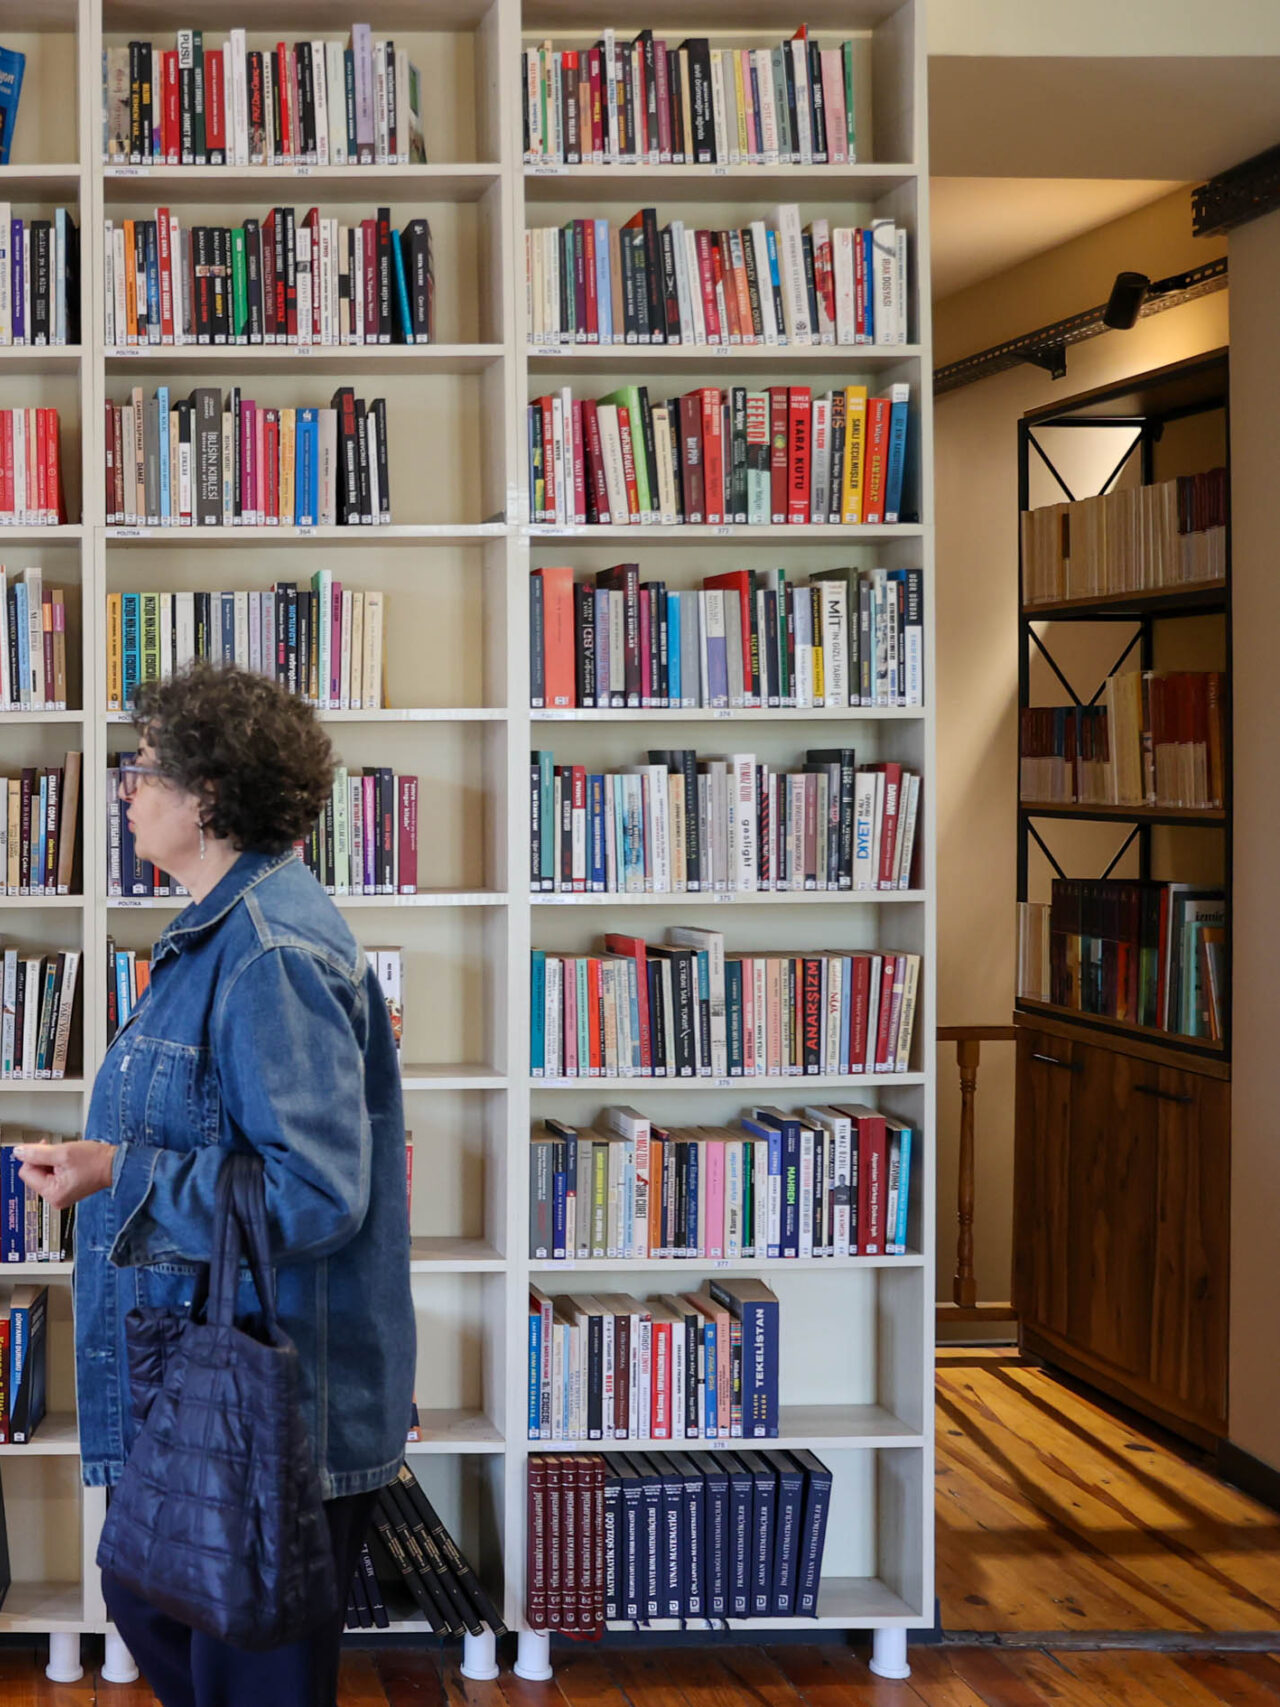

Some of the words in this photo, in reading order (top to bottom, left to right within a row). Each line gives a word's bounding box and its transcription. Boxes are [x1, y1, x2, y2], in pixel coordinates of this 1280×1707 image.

[180, 34, 191, 64] PUSU
[694, 79, 702, 114] örümceğin
[695, 116, 704, 139] ağında
[883, 259, 891, 274] IRAK
[883, 276, 893, 306] DOSYASI
[736, 411, 744, 429] Yalçın
[746, 398, 768, 444] EFENDİ
[207, 432, 219, 463] İBLİSİN
[795, 420, 804, 451] KARA
[208, 467, 219, 499] KIBLESİ
[795, 458, 804, 489] KUTU
[584, 629, 594, 658] ABD
[740, 762, 750, 783] YILMAZ
[886, 785, 897, 815] DAVAM
[742, 820, 751, 867] gaslight
[804, 962, 820, 1050] ANARŞİZM
[636, 1130, 647, 1152] YILMAZ
[839, 1125, 849, 1148] YILMAZ
[636, 1185, 646, 1197] SON
[787, 1167, 795, 1204] MAHREM
[754, 1309, 768, 1388] TEKELİSTAN
[541, 1392, 550, 1424] CENDERE
[668, 1510, 677, 1562] MATEMATİĞİ
[534, 1570, 543, 1587] TÜRK
[605, 1550, 615, 1596] MATEMATİK
[670, 1563, 678, 1588] YUNAN
